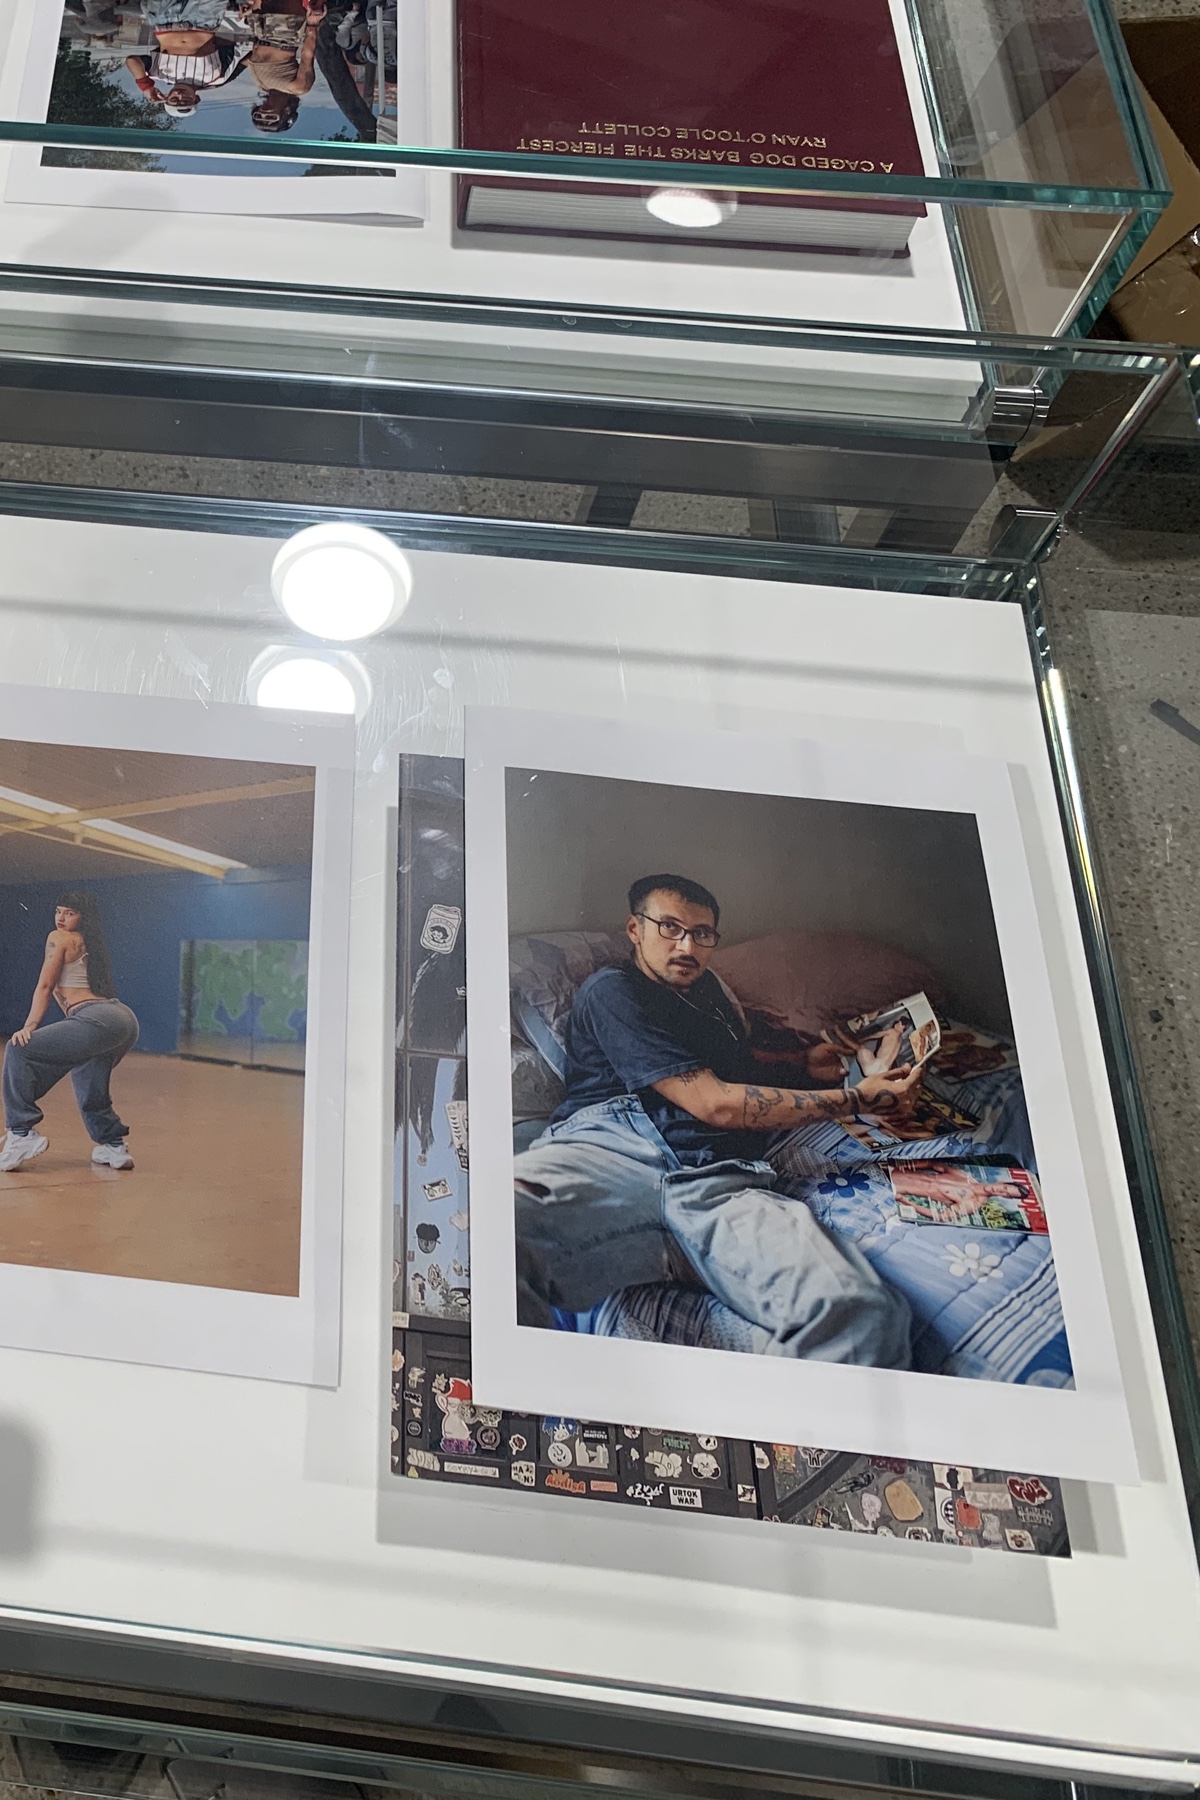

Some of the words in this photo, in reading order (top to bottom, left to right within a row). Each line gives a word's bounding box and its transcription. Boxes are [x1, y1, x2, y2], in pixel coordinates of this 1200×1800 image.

[578, 121, 671, 138] COLLETT
[675, 127, 766, 144] O'TOOLE
[516, 138, 615, 156] FIERCEST
[772, 133, 827, 149] RYAN
[624, 144, 666, 158] THE
[671, 147, 740, 163] BARKS
[750, 152, 796, 167] DOG
[801, 156, 875, 173] CAGED
[879, 161, 894, 173] A
[677, 1496, 695, 1506] WAR
